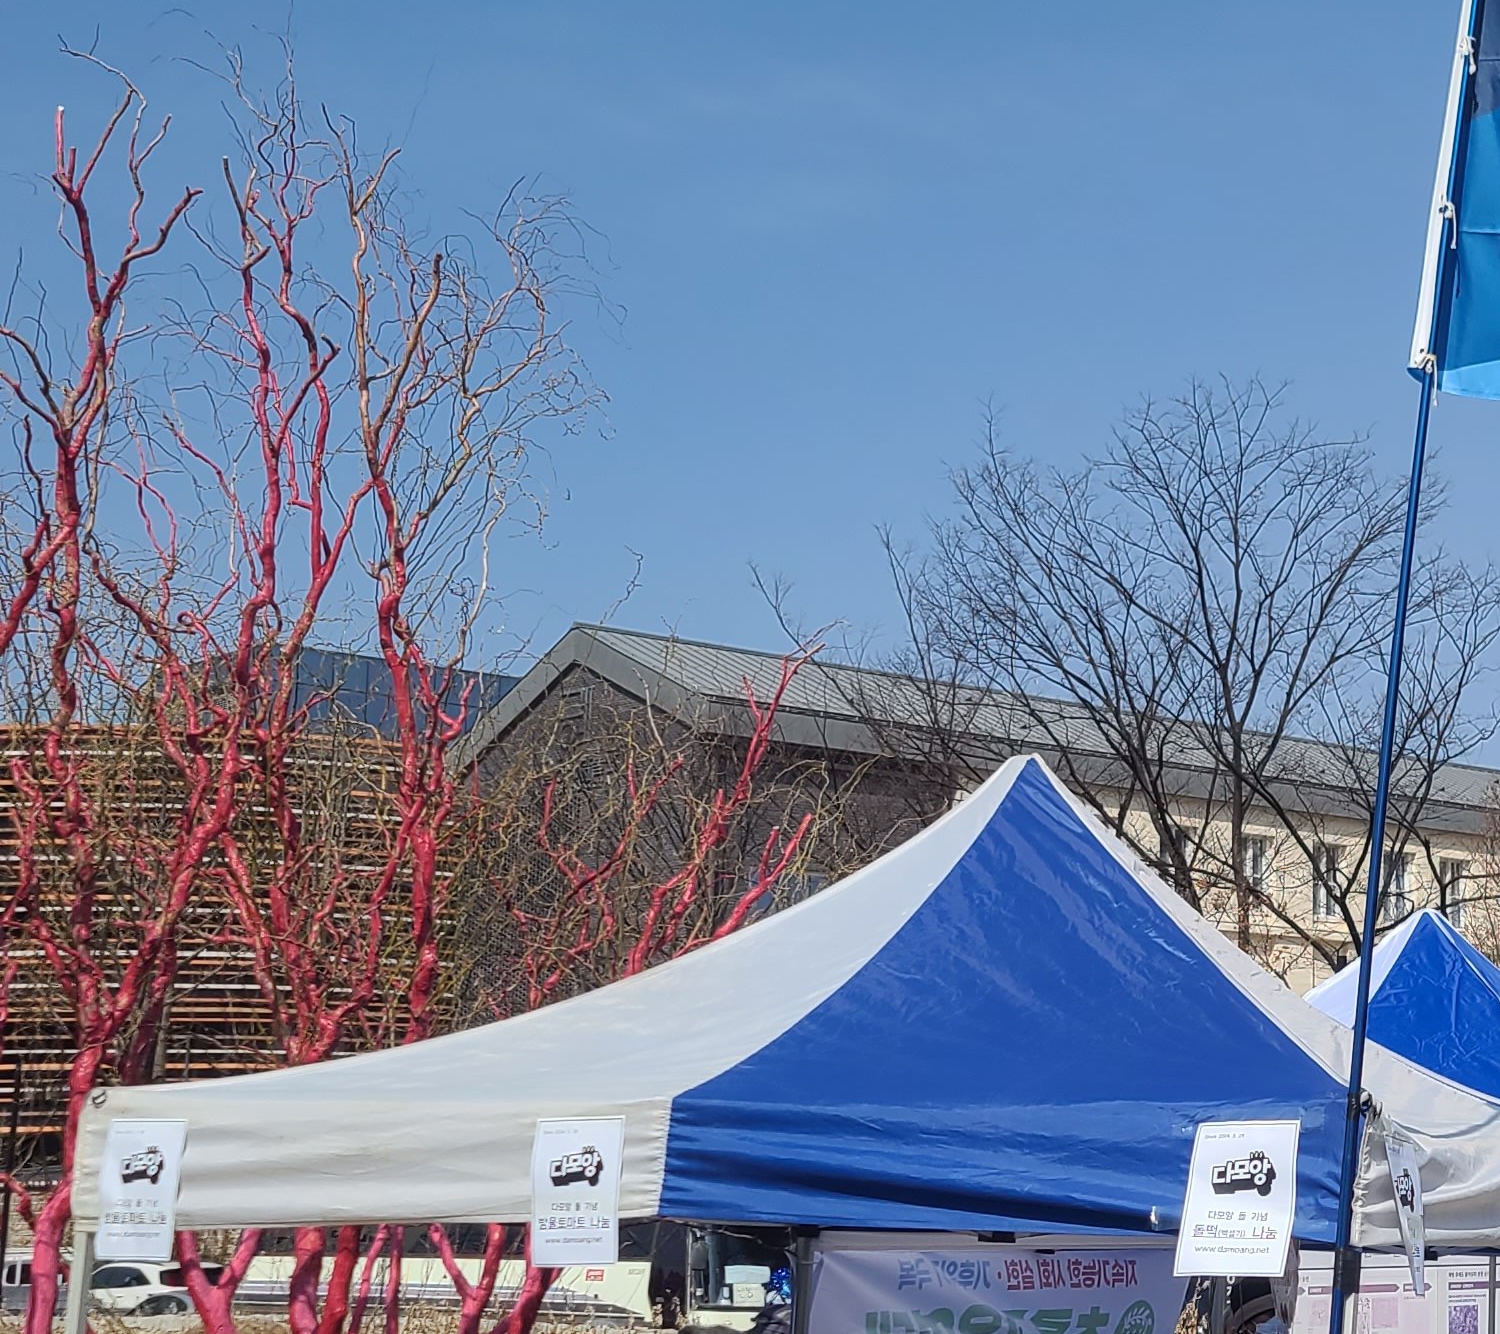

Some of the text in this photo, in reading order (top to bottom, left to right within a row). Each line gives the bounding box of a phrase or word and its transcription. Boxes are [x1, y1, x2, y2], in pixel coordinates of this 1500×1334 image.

[550, 1152, 602, 1178] 다모앙
[1211, 1157, 1272, 1187] 다모앙
[1207, 1210, 1234, 1221] 다모앙
[1251, 1211, 1268, 1222] 기념
[1252, 1226, 1277, 1239] 나눔
